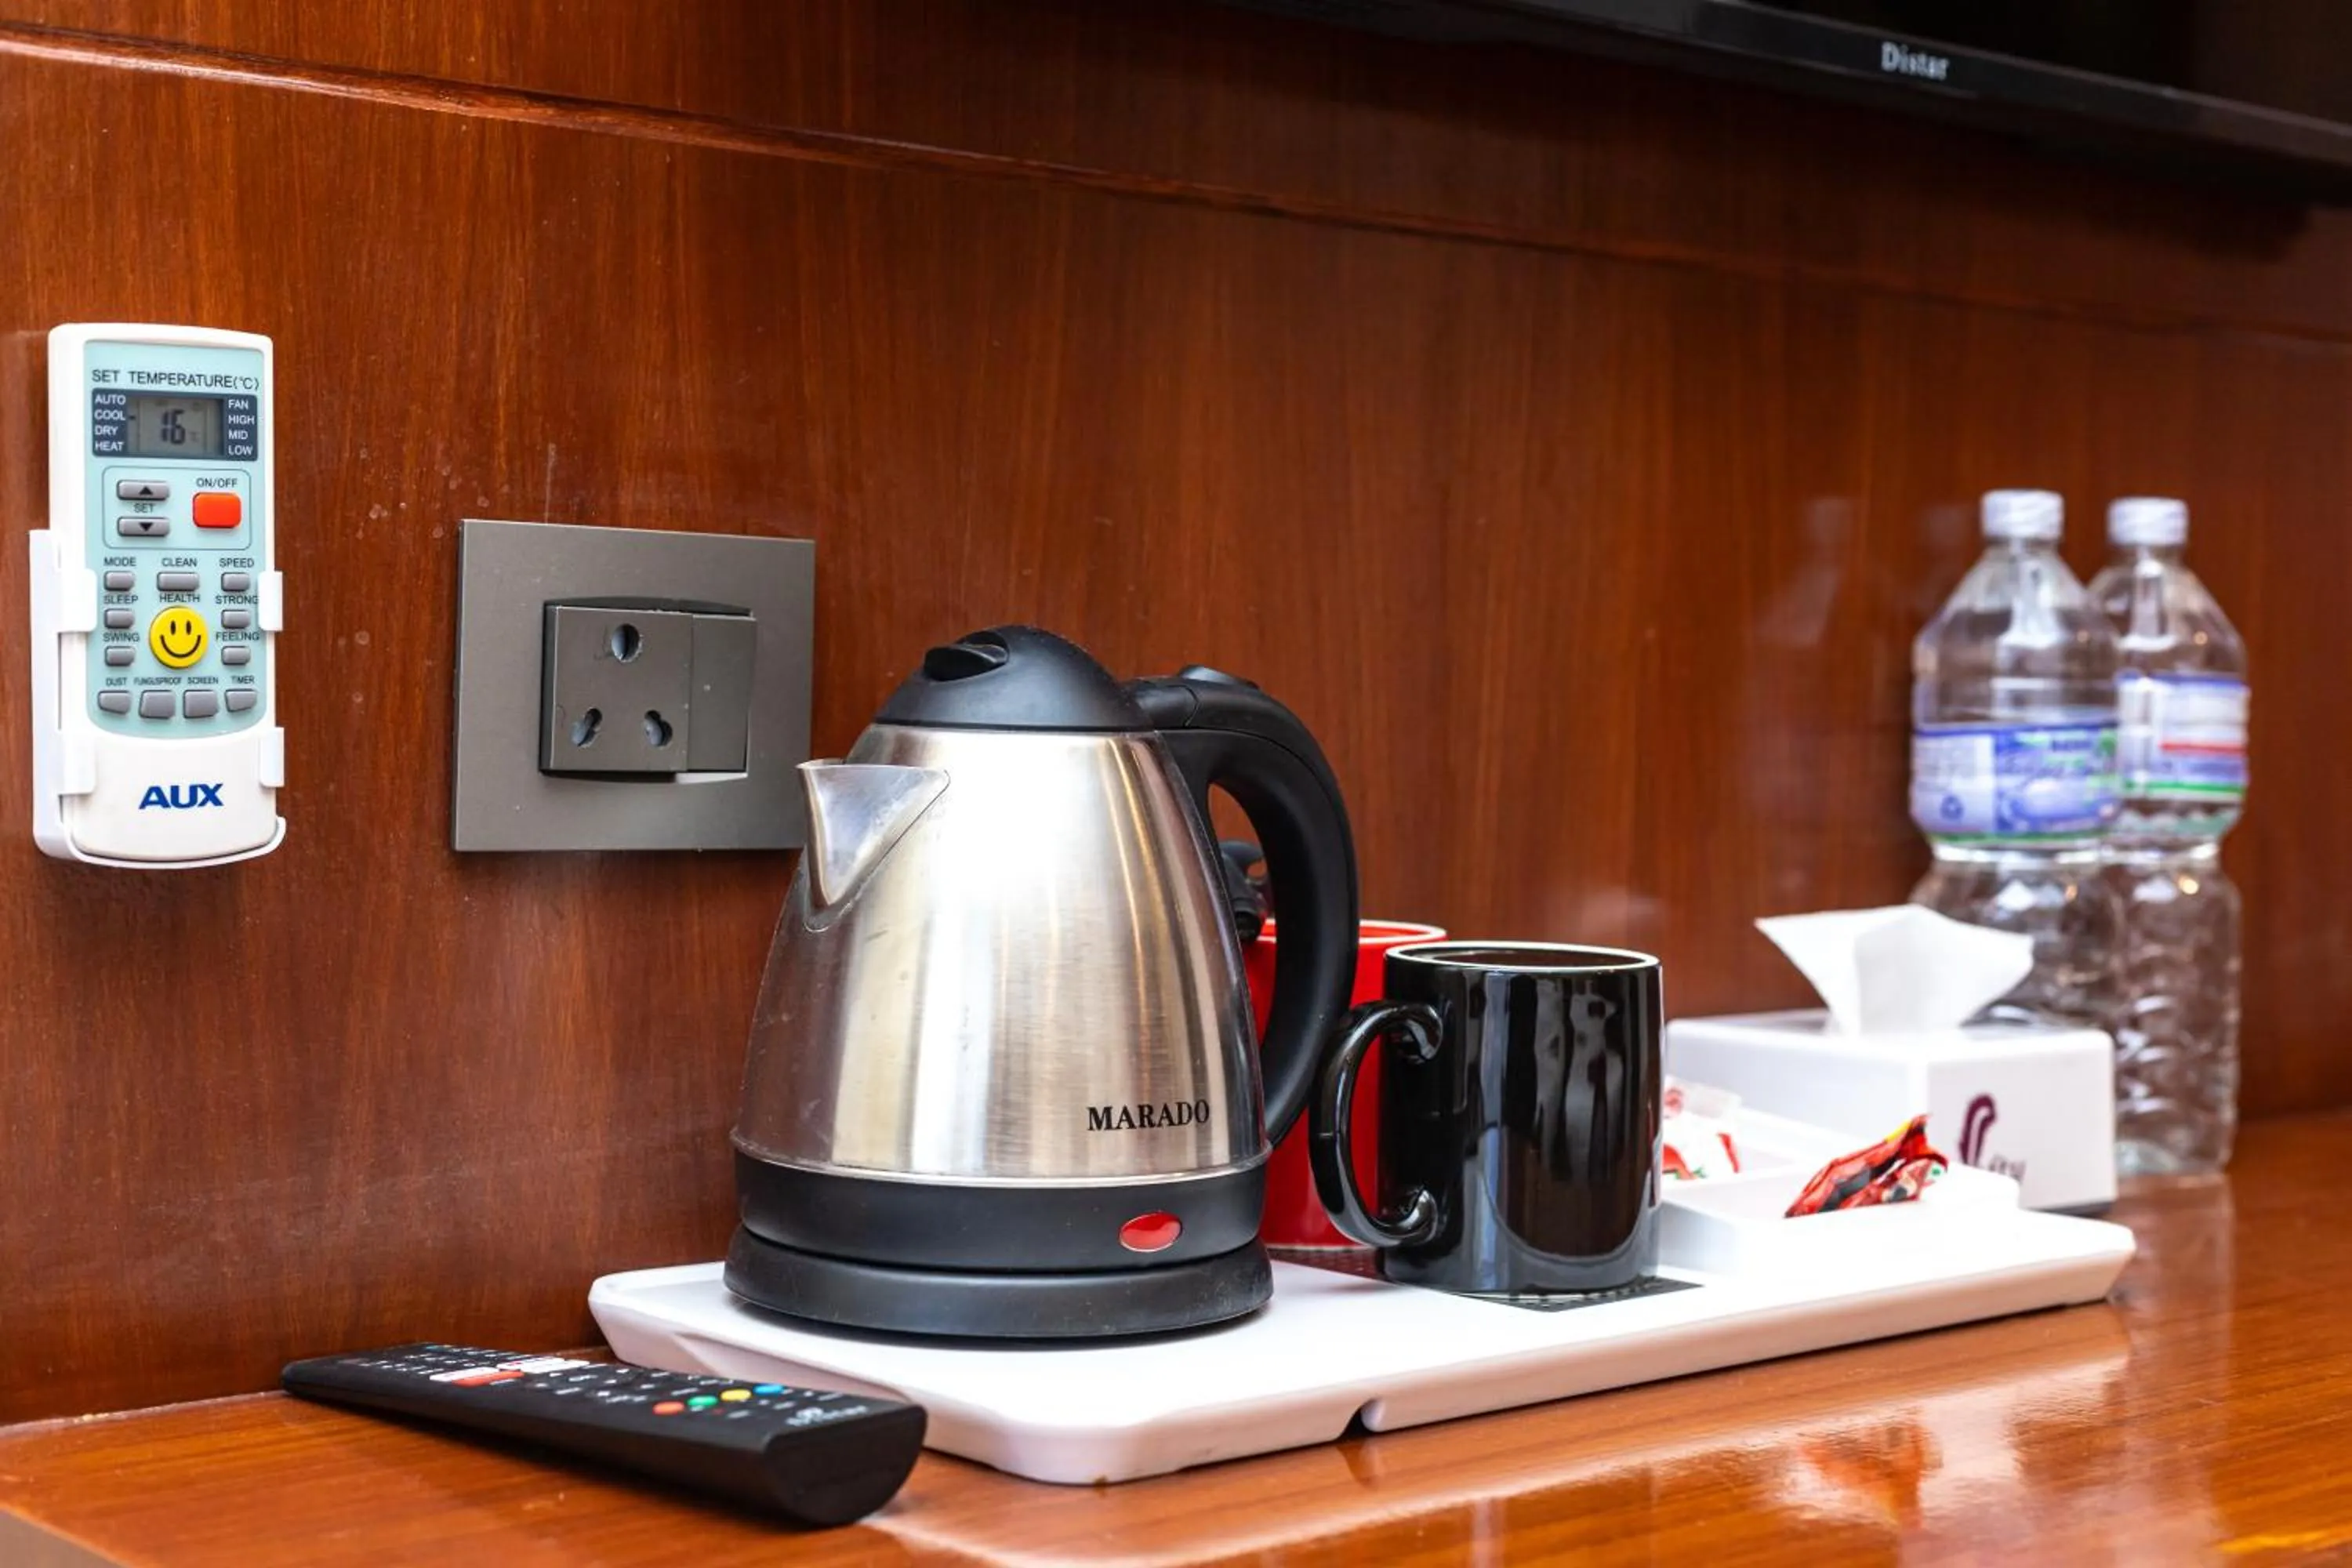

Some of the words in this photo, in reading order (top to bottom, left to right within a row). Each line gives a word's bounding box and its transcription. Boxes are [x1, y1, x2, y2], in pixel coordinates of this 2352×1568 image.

[92, 369, 120, 383] SET
[94, 394, 126, 405] AUTO
[227, 399, 249, 410] FAN
[94, 409, 126, 421] COOL
[227, 415, 256, 425] HIGH
[95, 426, 118, 436] DRY
[161, 408, 186, 445] 16
[227, 430, 249, 441] MID
[95, 441, 124, 452] HEAT
[227, 445, 253, 456] LOW
[196, 477, 238, 488] ON/OFF
[133, 503, 155, 514] SET
[103, 557, 136, 567] MODE
[162, 557, 198, 568] CLEAN
[219, 557, 255, 568] SPEED
[103, 594, 139, 605] SLEEP
[159, 593, 201, 604] HEALTH
[215, 594, 260, 605] STRONG
[103, 632, 140, 643] SWING
[216, 632, 260, 642] FEELING
[106, 677, 128, 686] DUST
[187, 677, 219, 685] SCREEN
[231, 675, 255, 684] TIMER
[138, 782, 224, 810] AUX
[1087, 1099, 1210, 1131] MARADO
